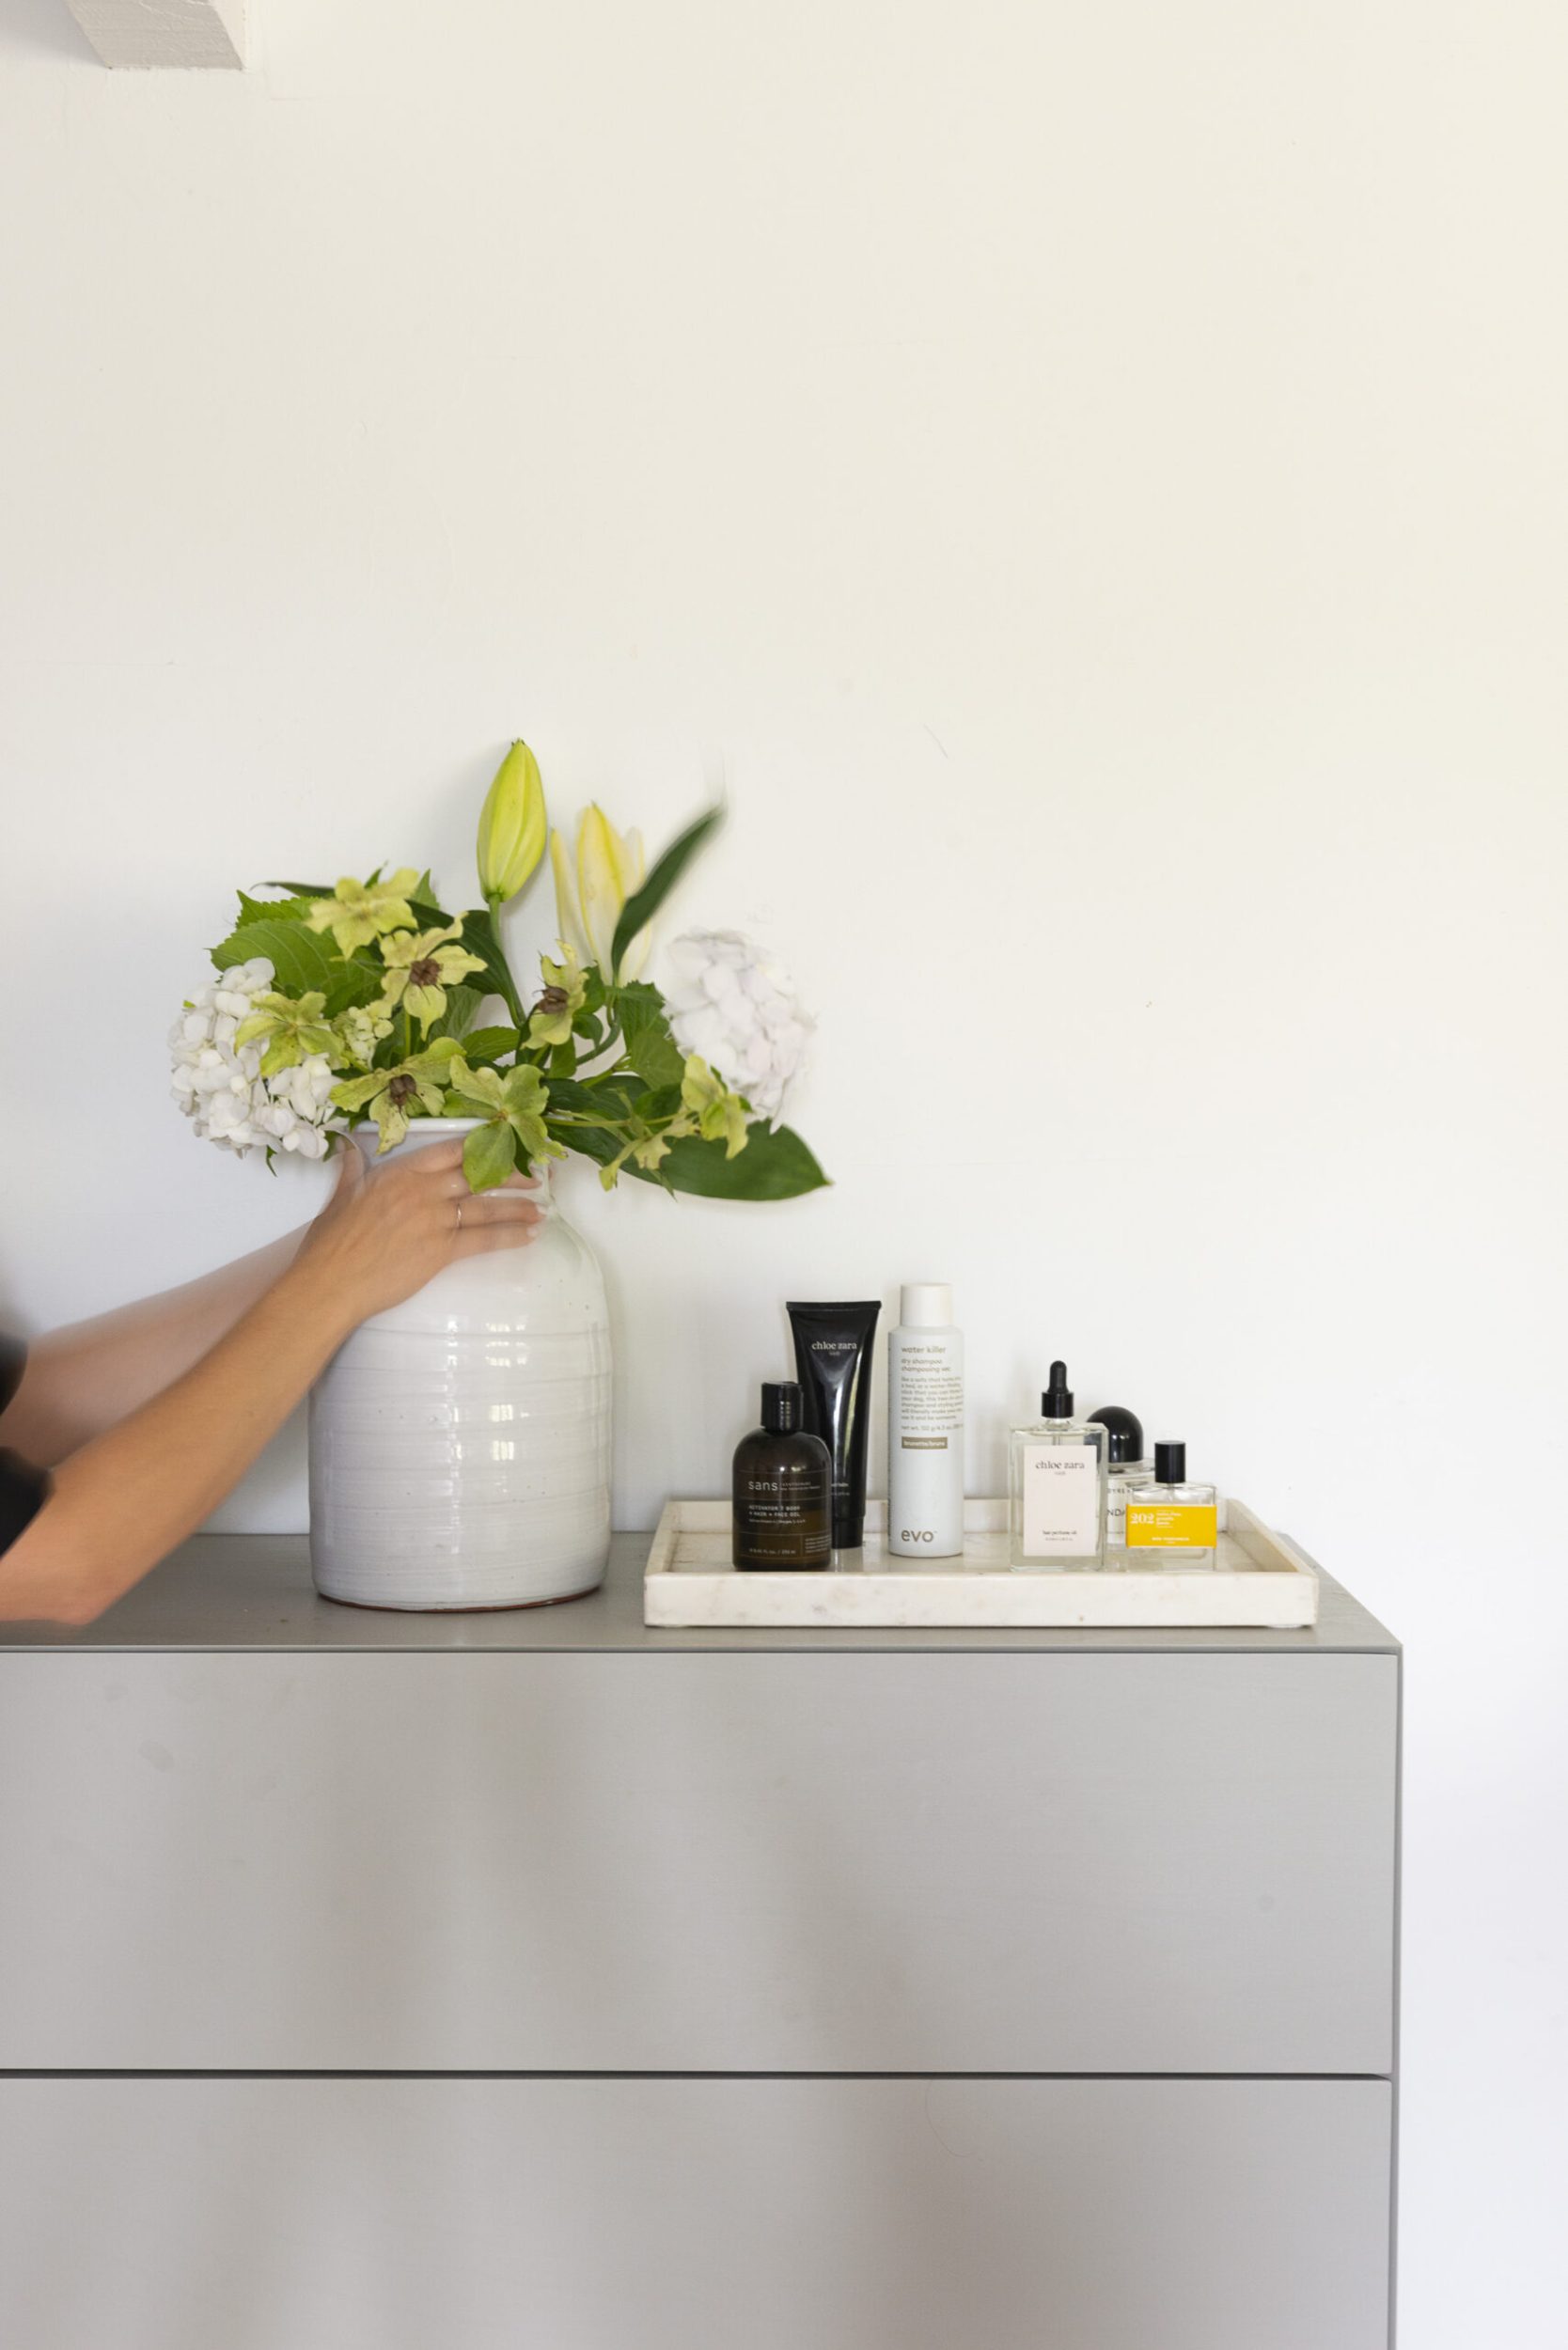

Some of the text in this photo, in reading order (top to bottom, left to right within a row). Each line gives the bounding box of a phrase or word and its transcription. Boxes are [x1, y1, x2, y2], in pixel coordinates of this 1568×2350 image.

[811, 1340, 837, 1350] chloe
[1035, 1460, 1062, 1469] chloe
[747, 1480, 778, 1491] sans
[1130, 1512, 1154, 1525] 202
[902, 1529, 933, 1543] evo
